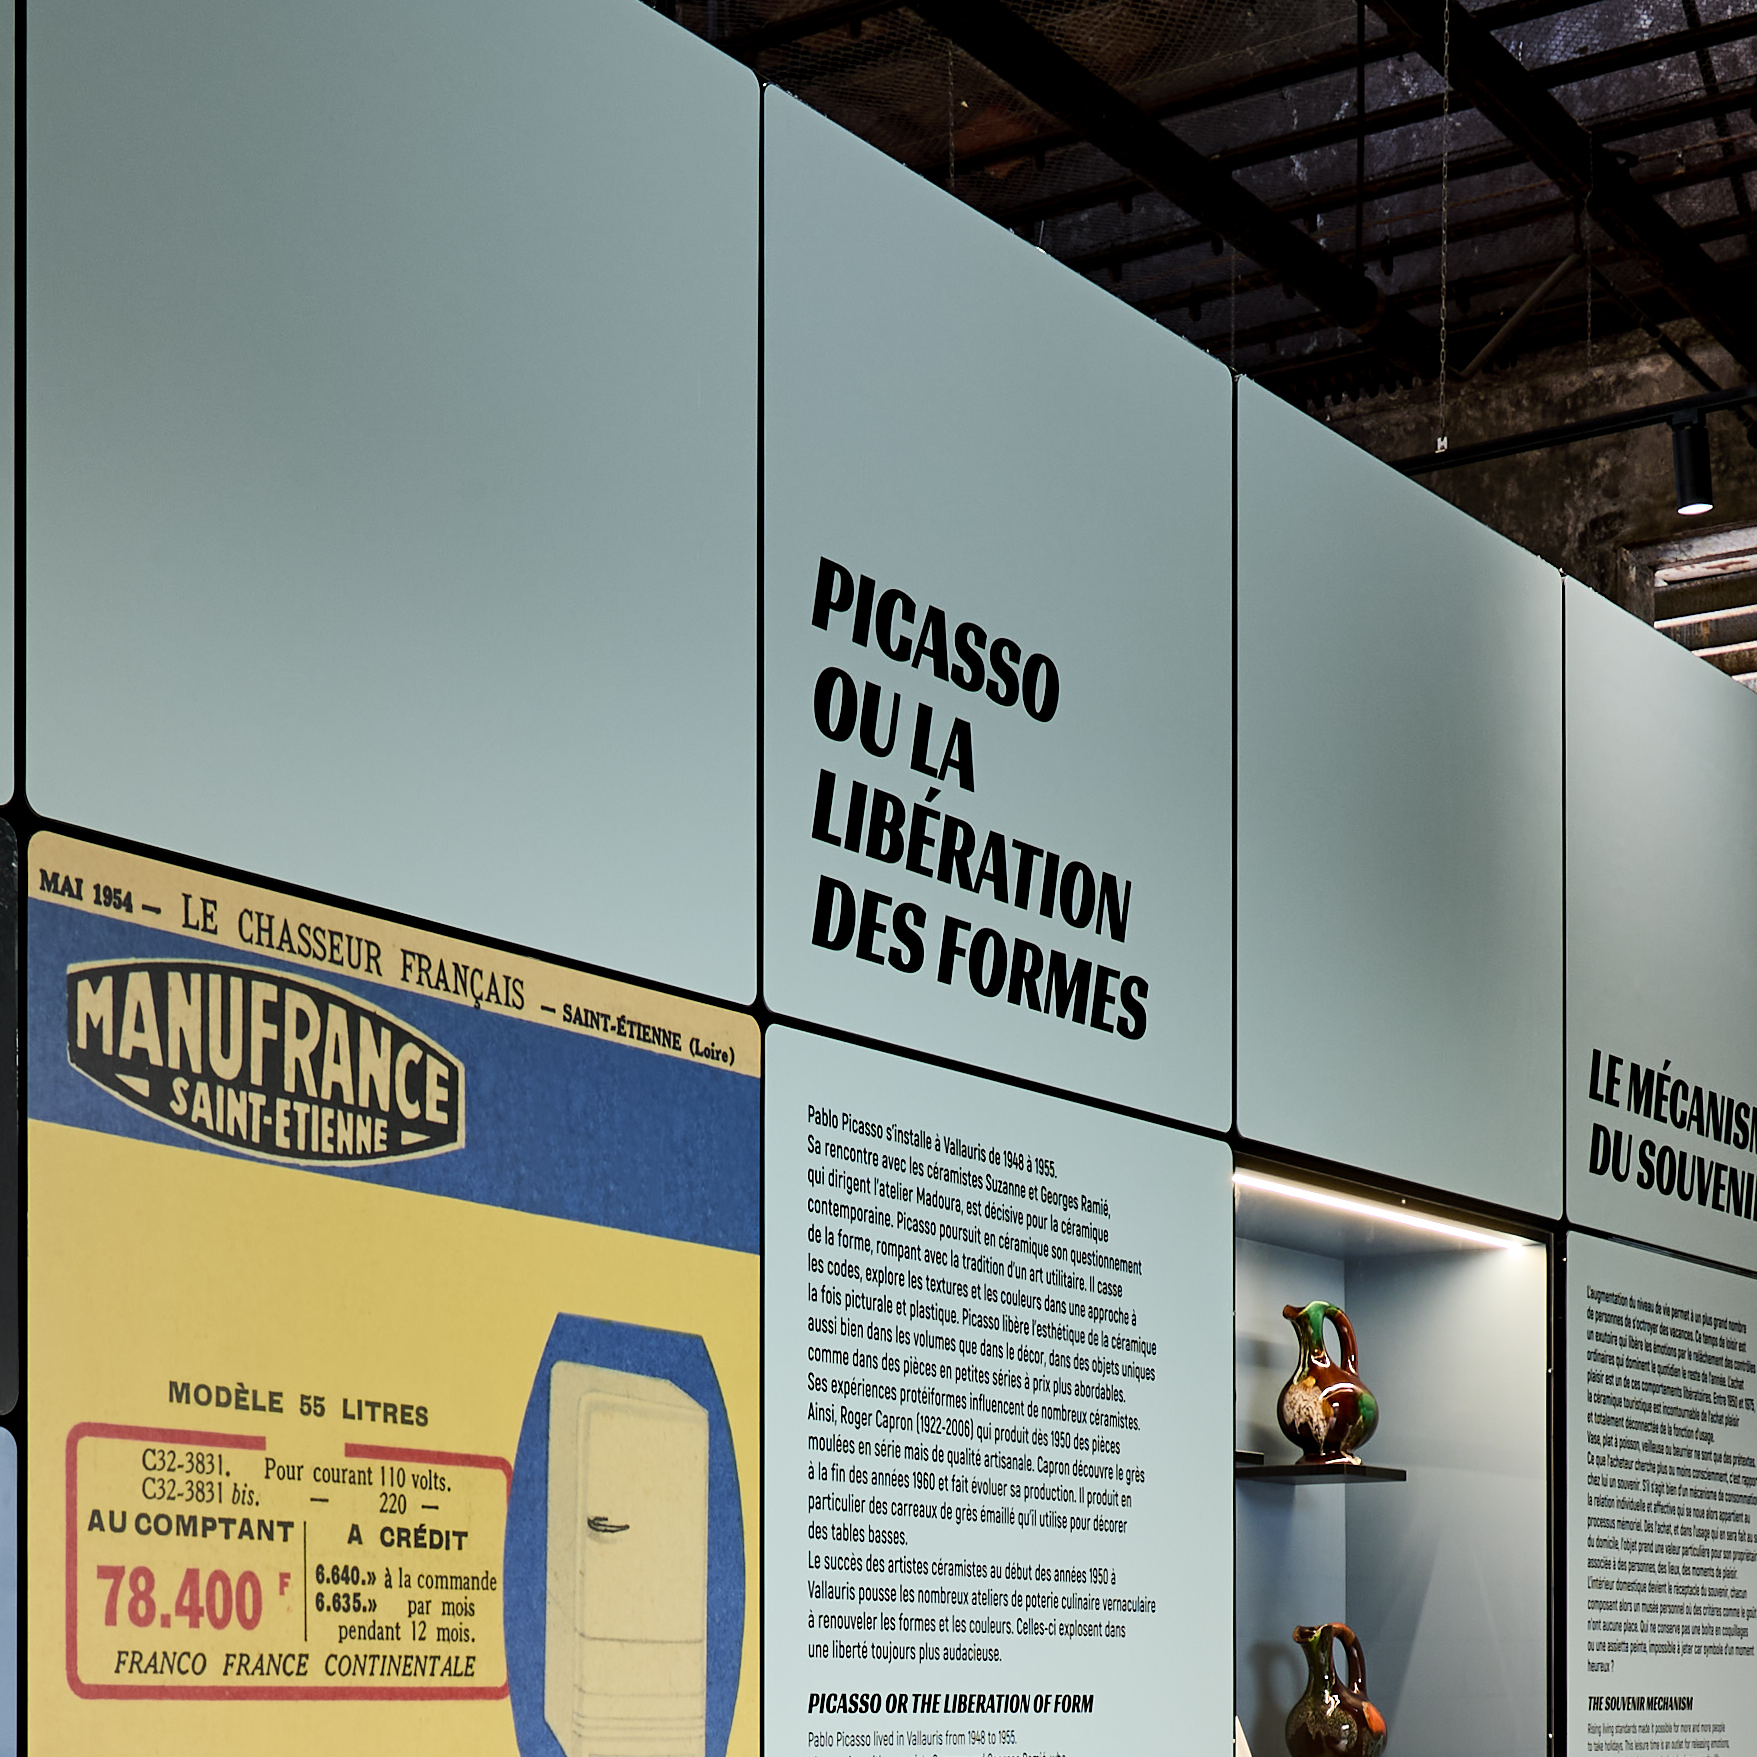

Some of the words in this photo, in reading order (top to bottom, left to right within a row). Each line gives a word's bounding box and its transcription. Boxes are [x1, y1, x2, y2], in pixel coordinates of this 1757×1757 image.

[811, 556, 1061, 723] PICASSO
[812, 666, 902, 759] OU
[910, 702, 975, 793] LA
[811, 768, 1132, 944] LIBÉRATION
[39, 868, 84, 902] MAI
[93, 883, 134, 914] 1954
[182, 893, 218, 935] LE
[237, 909, 382, 978] CHASSEUR
[400, 949, 526, 1011] FRANÇAIS
[563, 1003, 682, 1052] SAINT-ÉTIENNE
[689, 1037, 735, 1067] (Loire)
[811, 874, 927, 974] DES
[937, 915, 1149, 1041] FORMES
[76, 971, 450, 1125] MANUFRANCE
[1588, 1048, 1624, 1108] LE
[168, 1077, 388, 1156] SAINT-ETIENNE
[808, 1104, 839, 1129] Pablo
[842, 1112, 884, 1140] Picasso
[886, 1123, 932, 1151] s'installe
[935, 1133, 941, 1152] à
[943, 1136, 987, 1163] Vallauris
[989, 1147, 1001, 1166] de
[1003, 1150, 1025, 1171] 1948
[1027, 1154, 1033, 1173] à
[1035, 1157, 1058, 1179] 1955.
[808, 1134, 821, 1155] Sa
[825, 1142, 879, 1168] rencontre
[882, 1154, 907, 1173] avec
[909, 1156, 925, 1177] les
[927, 1161, 984, 1190] céramistes
[986, 1173, 1026, 1199] Suzanne
[1028, 1185, 1039, 1202] et
[1041, 1185, 1079, 1212] Georges
[1081, 1194, 1111, 1220] Ramié,
[1588, 1122, 1633, 1183] DU
[808, 1168, 825, 1188] qui
[828, 1169, 871, 1196] dirigent
[874, 1177, 914, 1203] l'atelier
[917, 1186, 964, 1216] Madoura,
[966, 1200, 982, 1218] est
[985, 1200, 1024, 1226] décisive
[1026, 1213, 1048, 1231] pour
[1050, 1214, 1059, 1233] la
[1061, 1217, 1109, 1245] céramique
[808, 1198, 894, 1228] contemporaine.
[897, 1211, 937, 1236] Picasso
[940, 1223, 982, 1245] poursuit
[984, 1232, 996, 1248] en
[999, 1232, 1049, 1260] céramique
[1051, 1245, 1068, 1262] son
[1070, 1249, 1143, 1276] questionnement
[169, 1380, 284, 1414] MODÈLE
[299, 1394, 326, 1418] 55
[342, 1398, 429, 1428] LITRES
[142, 1448, 231, 1478] C32-3831.
[264, 1457, 304, 1482] Pour
[313, 1466, 374, 1486] courant
[381, 1466, 406, 1489] 110
[411, 1469, 452, 1493] volts.
[142, 1476, 223, 1504] C32-3831
[231, 1482, 260, 1507] bis.
[379, 1492, 407, 1515] 220
[87, 1509, 127, 1534] AU
[134, 1512, 295, 1543] COMPTANT
[347, 1523, 364, 1546] A
[380, 1523, 469, 1551] CRÉDIT
[96, 1565, 263, 1631] 78.400
[384, 1567, 393, 1590] à
[398, 1567, 412, 1589] la
[417, 1570, 497, 1592] commande
[407, 1599, 432, 1619] par
[441, 1596, 475, 1617] mois
[338, 1619, 402, 1644] pendant
[412, 1620, 427, 1642] 12
[436, 1622, 476, 1644] mois.
[114, 1650, 207, 1676] FRANCO
[222, 1653, 310, 1677] FRANCE
[325, 1653, 477, 1678] CONTINENTALE
[808, 1693, 882, 1714] PICASSO
[885, 1693, 909, 1714] OR
[912, 1693, 942, 1714] THE
[943, 1694, 1031, 1714] LIBERATION
[1033, 1694, 1053, 1714] OF
[1053, 1694, 1095, 1714] FORM
[1588, 1696, 1605, 1712] THE
[1604, 1696, 1646, 1712] SOUVENIR
[1646, 1696, 1694, 1711] MECHANISM
[808, 1731, 834, 1748] Pablo
[836, 1731, 871, 1747] Picasso
[874, 1731, 894, 1747] lived
[896, 1730, 905, 1746] in
[906, 1730, 943, 1746] Vallauris
[945, 1730, 966, 1746] from
[968, 1730, 986, 1746] 1948
[988, 1732, 996, 1745] to
[998, 1729, 1017, 1745] 1955.
